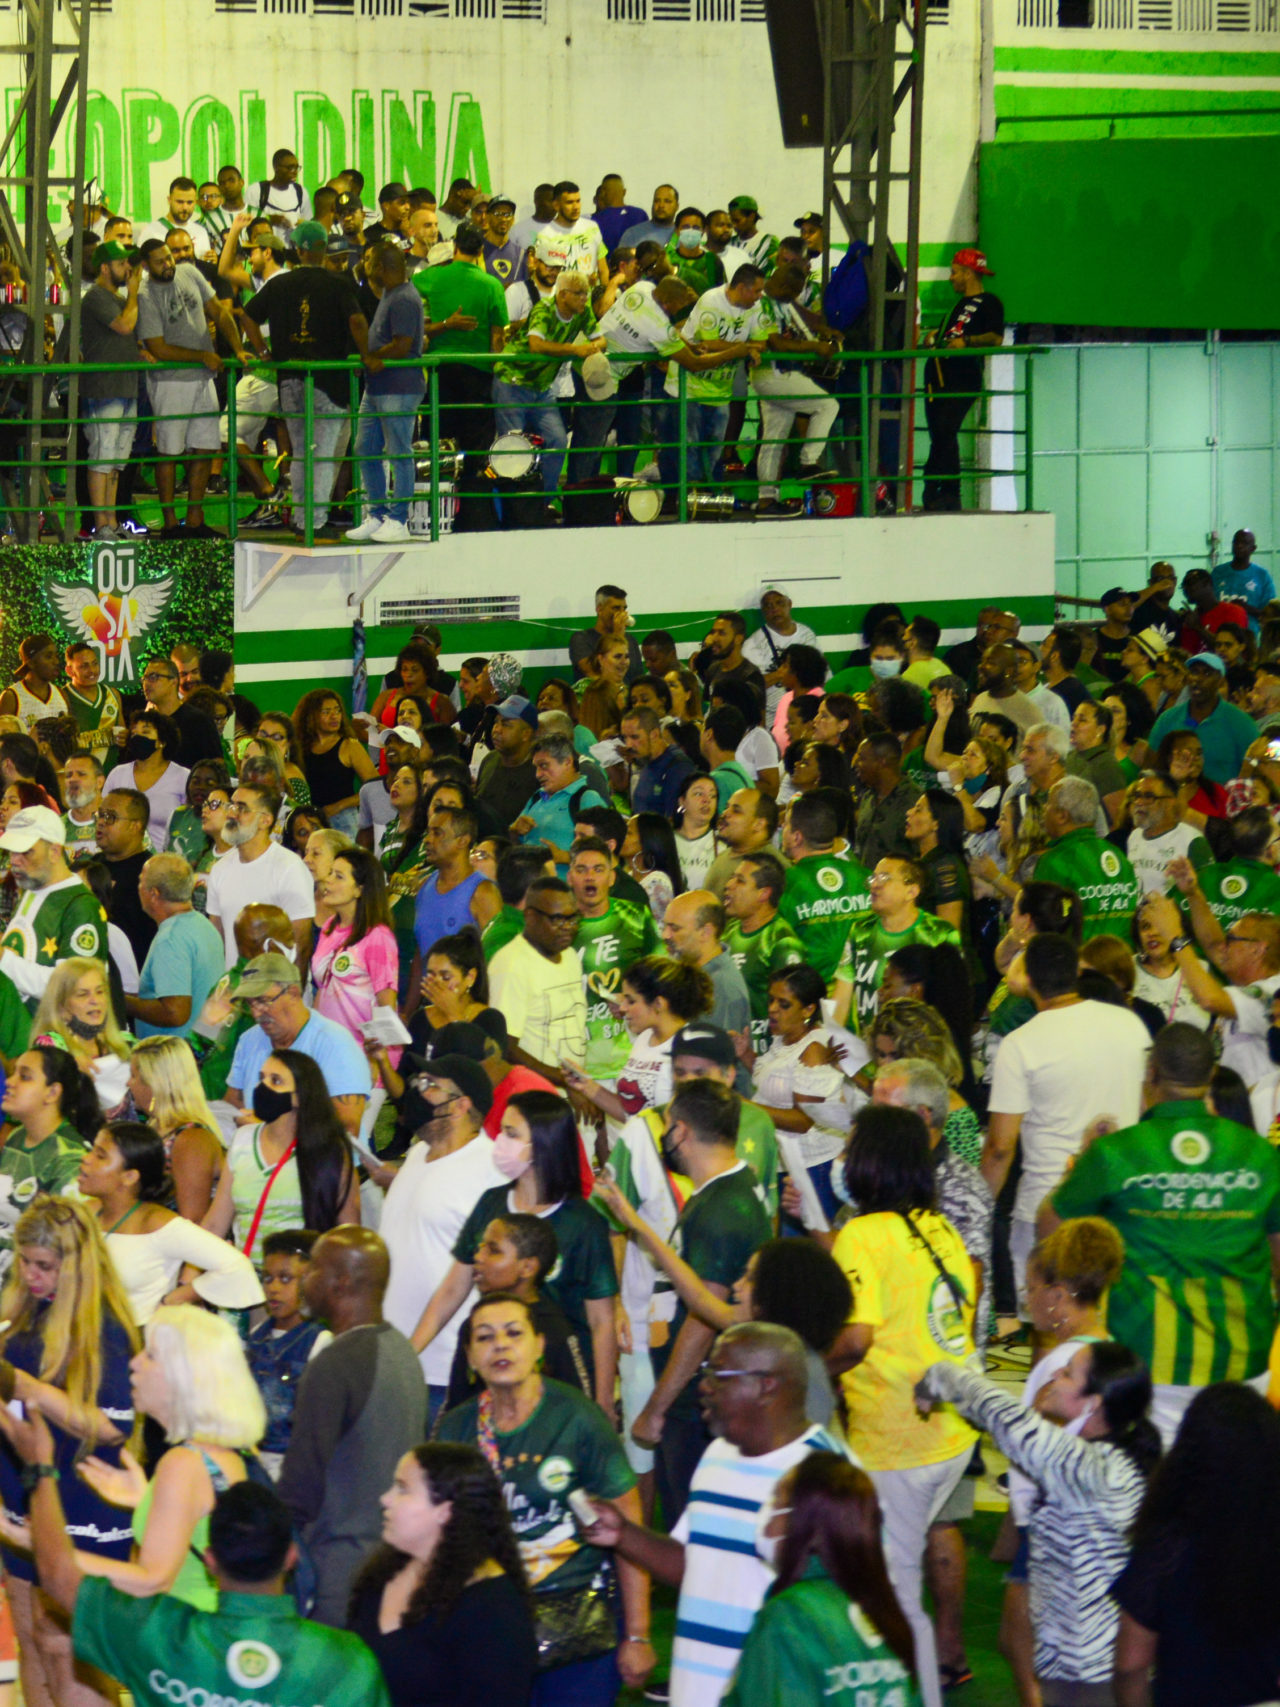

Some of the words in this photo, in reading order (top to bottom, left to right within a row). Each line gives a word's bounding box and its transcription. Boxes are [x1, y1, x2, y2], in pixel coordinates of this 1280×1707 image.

[796, 893, 872, 920] HARMONIA
[591, 934, 620, 966] TE
[1162, 1191, 1187, 1209] DE
